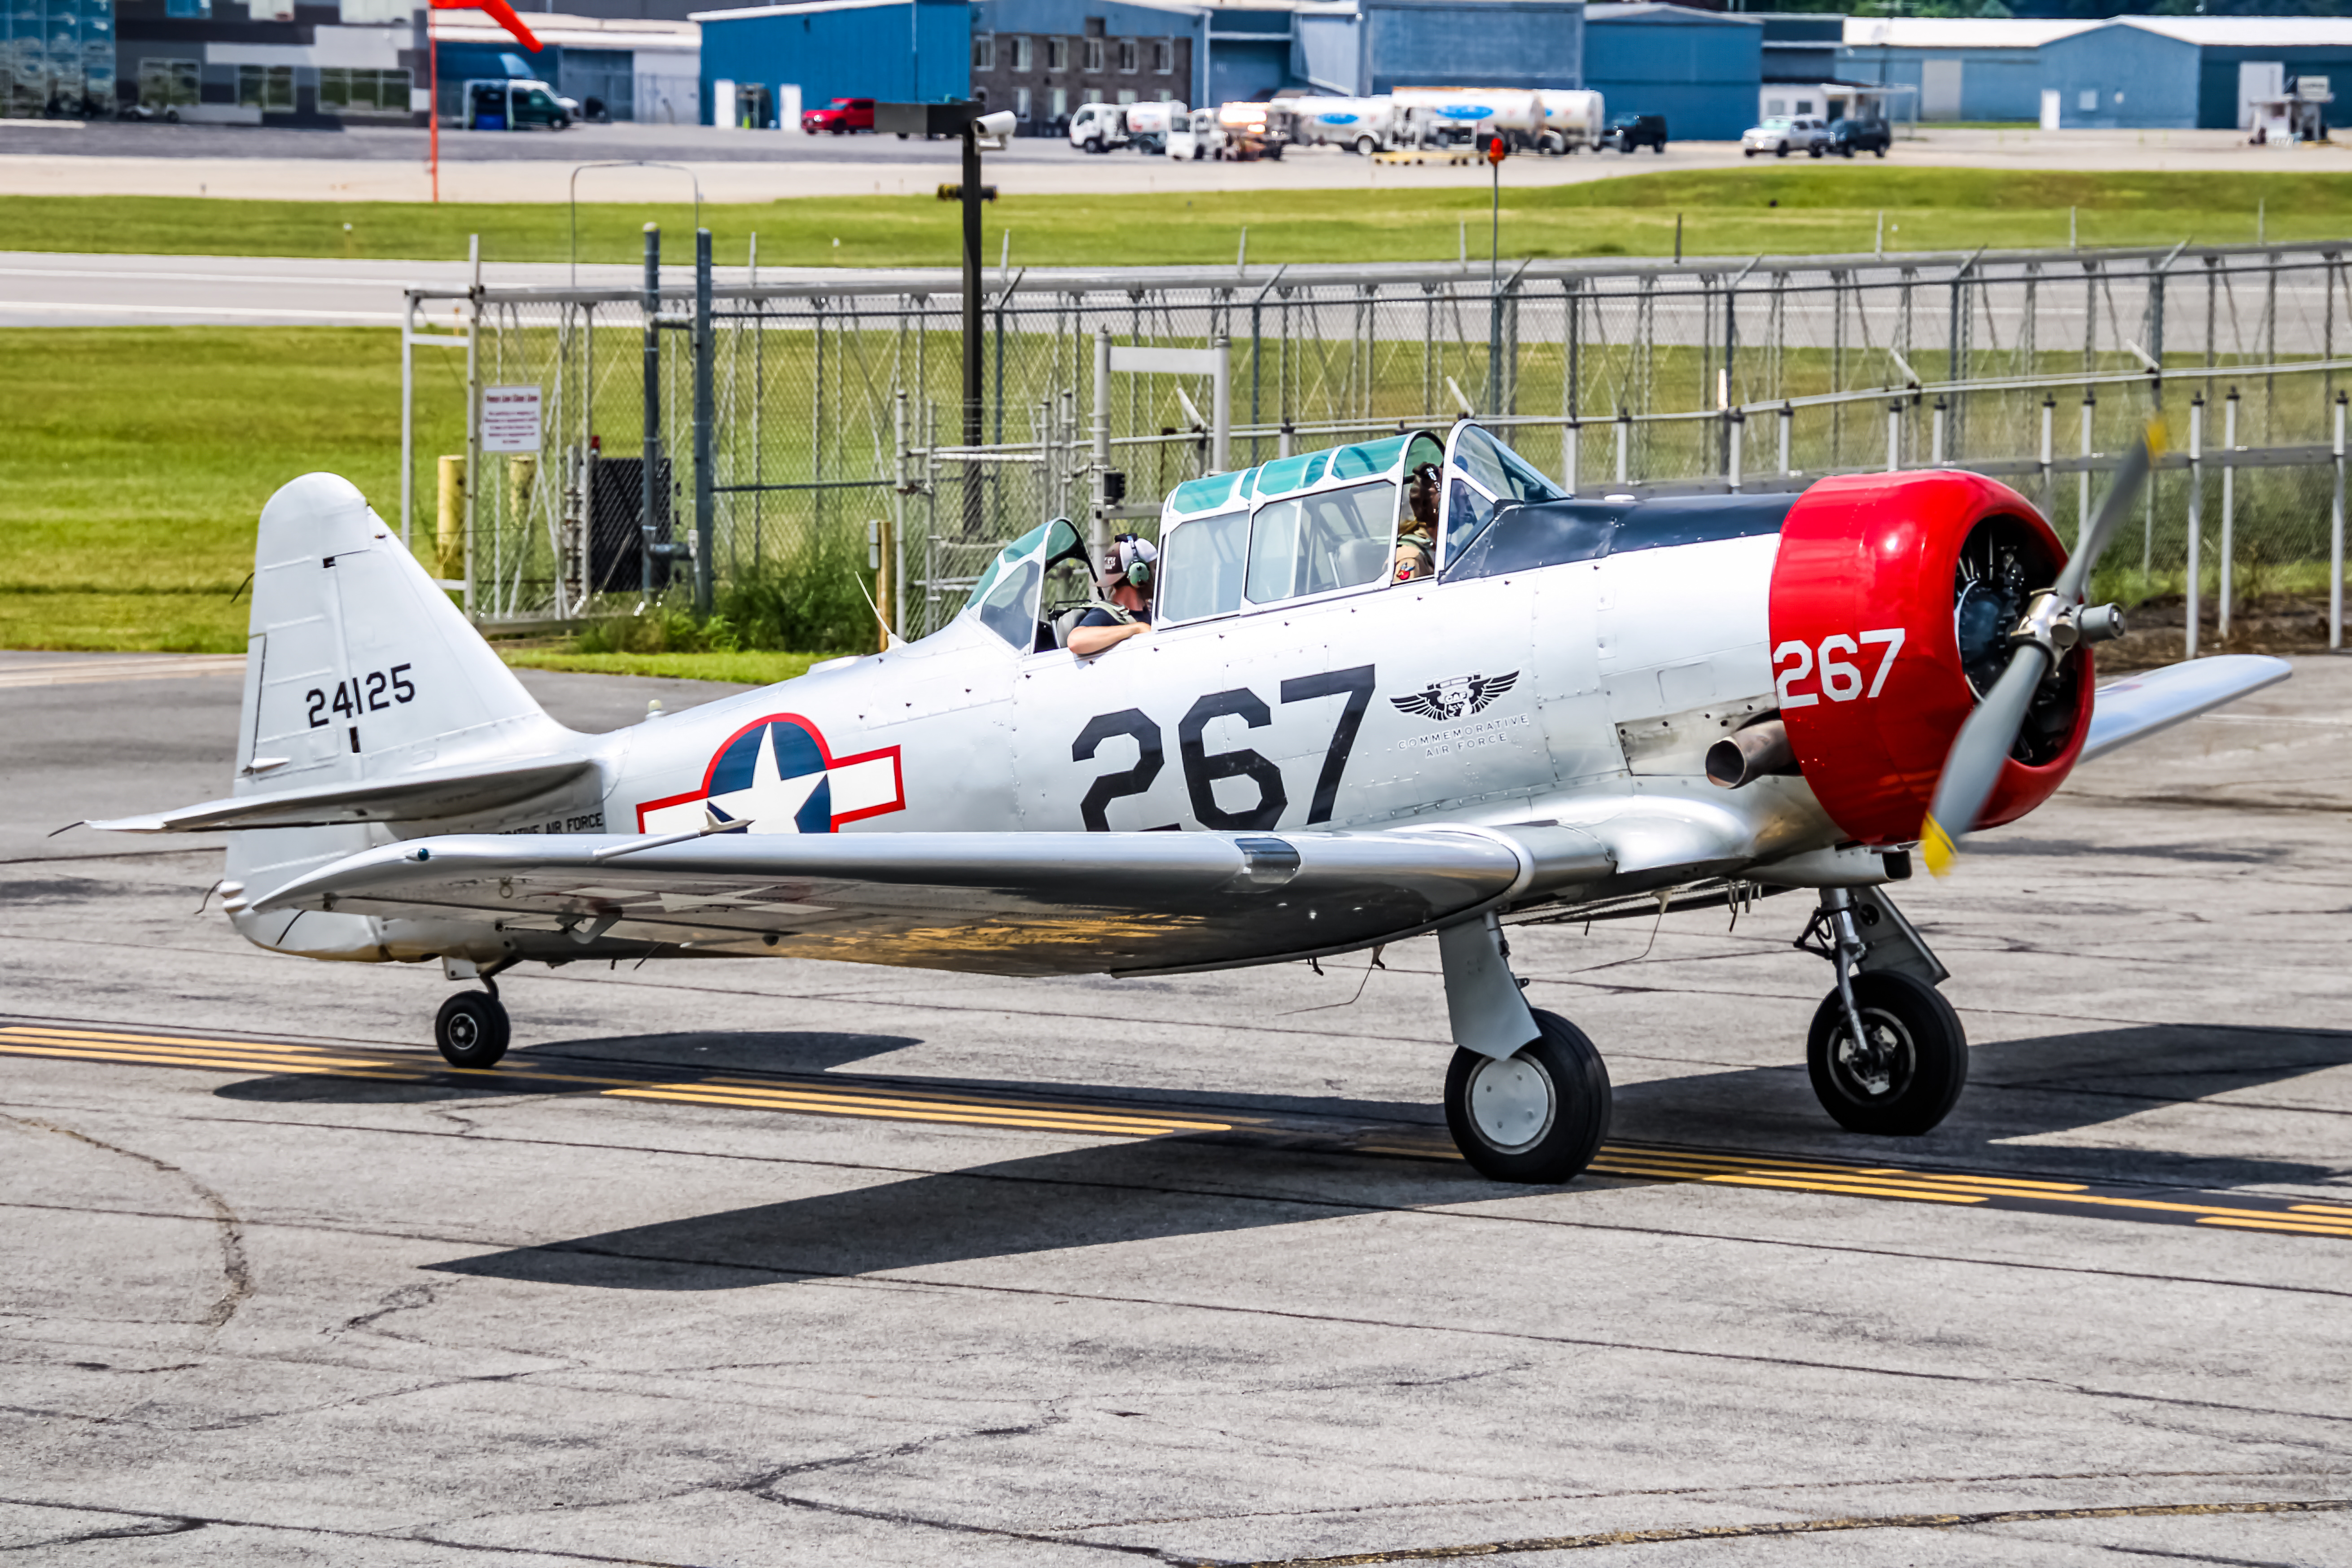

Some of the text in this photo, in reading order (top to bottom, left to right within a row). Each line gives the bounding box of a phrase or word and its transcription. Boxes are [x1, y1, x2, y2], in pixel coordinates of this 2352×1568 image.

[1773, 627, 1905, 710] 267
[306, 662, 416, 728] 24125
[1445, 692, 1467, 703] CAF
[1071, 664, 1376, 832] 267
[1398, 714, 1529, 749] COMMEMORATIVE
[1426, 732, 1507, 758] AIR FORCE
[546, 820, 563, 834] AIR
[567, 812, 604, 832] FORCE
